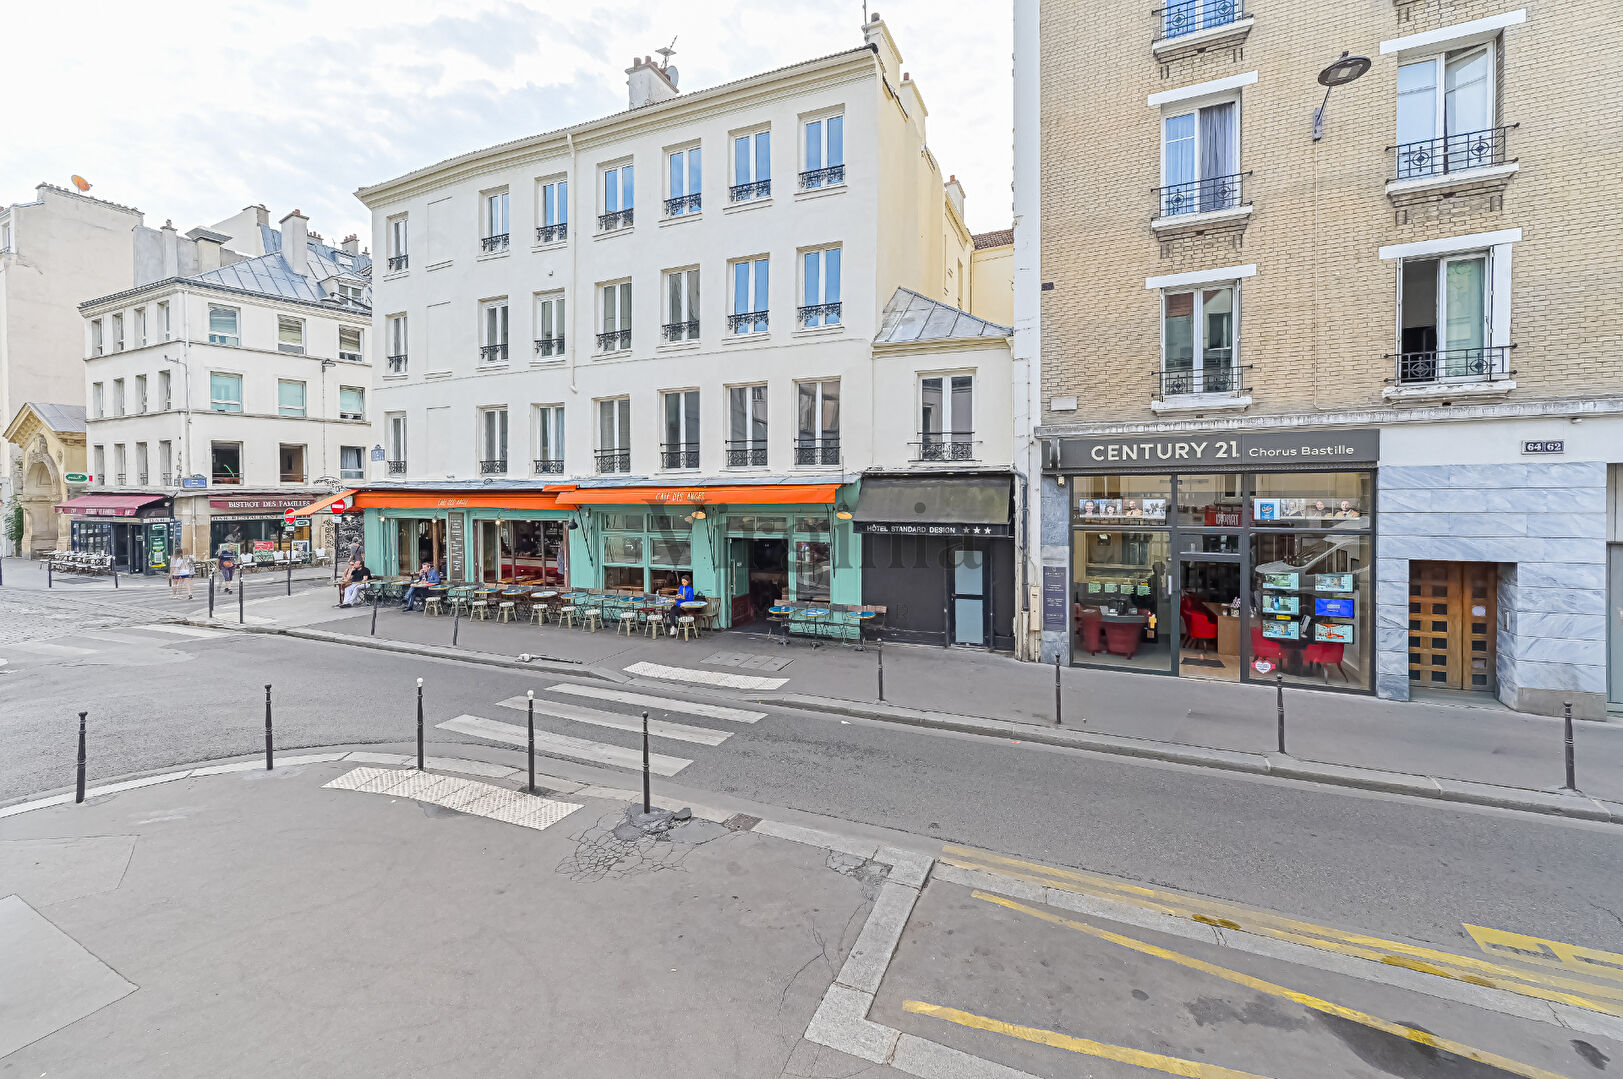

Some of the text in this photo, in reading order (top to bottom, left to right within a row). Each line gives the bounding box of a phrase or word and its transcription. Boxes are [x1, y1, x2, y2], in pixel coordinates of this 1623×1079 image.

[1091, 441, 1208, 461] CENTURY
[1249, 444, 1355, 457] Chorus Bastille
[1527, 443, 1541, 451] 64
[1546, 443, 1561, 451] 62
[672, 492, 684, 502] DES
[686, 491, 705, 502] ANGES
[866, 524, 956, 534] HÔTEL STANDARD DESIGN
